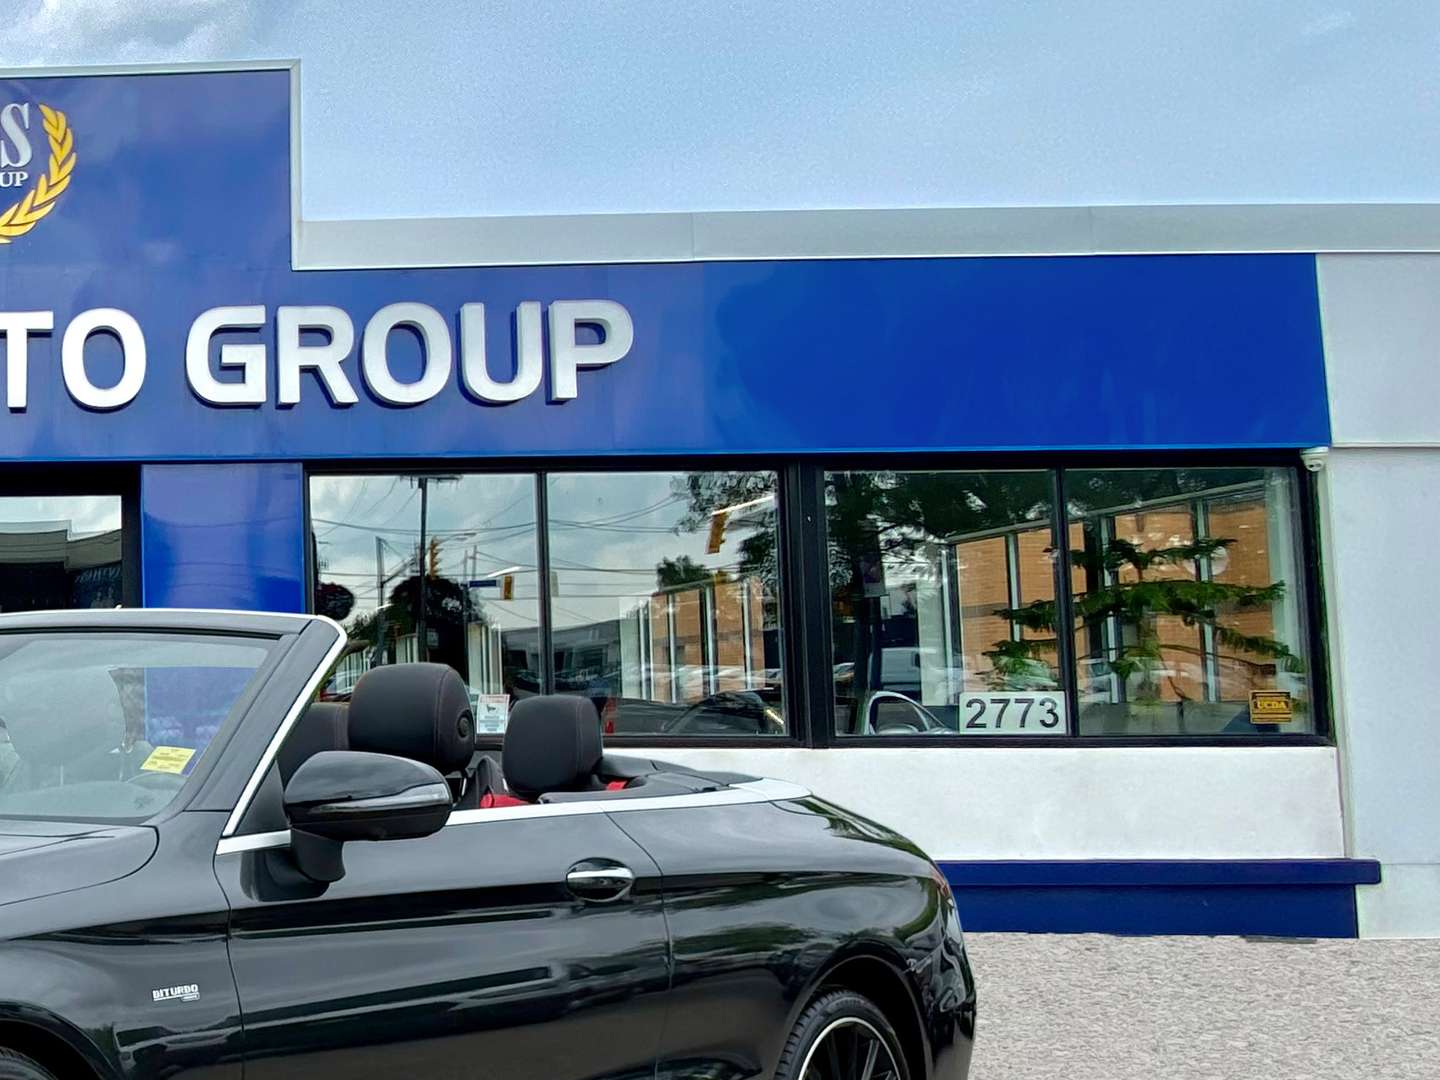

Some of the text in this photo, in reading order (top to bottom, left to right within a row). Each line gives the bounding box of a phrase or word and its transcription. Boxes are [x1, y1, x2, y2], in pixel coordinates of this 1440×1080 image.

[185, 300, 635, 406] GROUP
[965, 698, 1059, 728] 2773
[1257, 701, 1287, 709] UCDA
